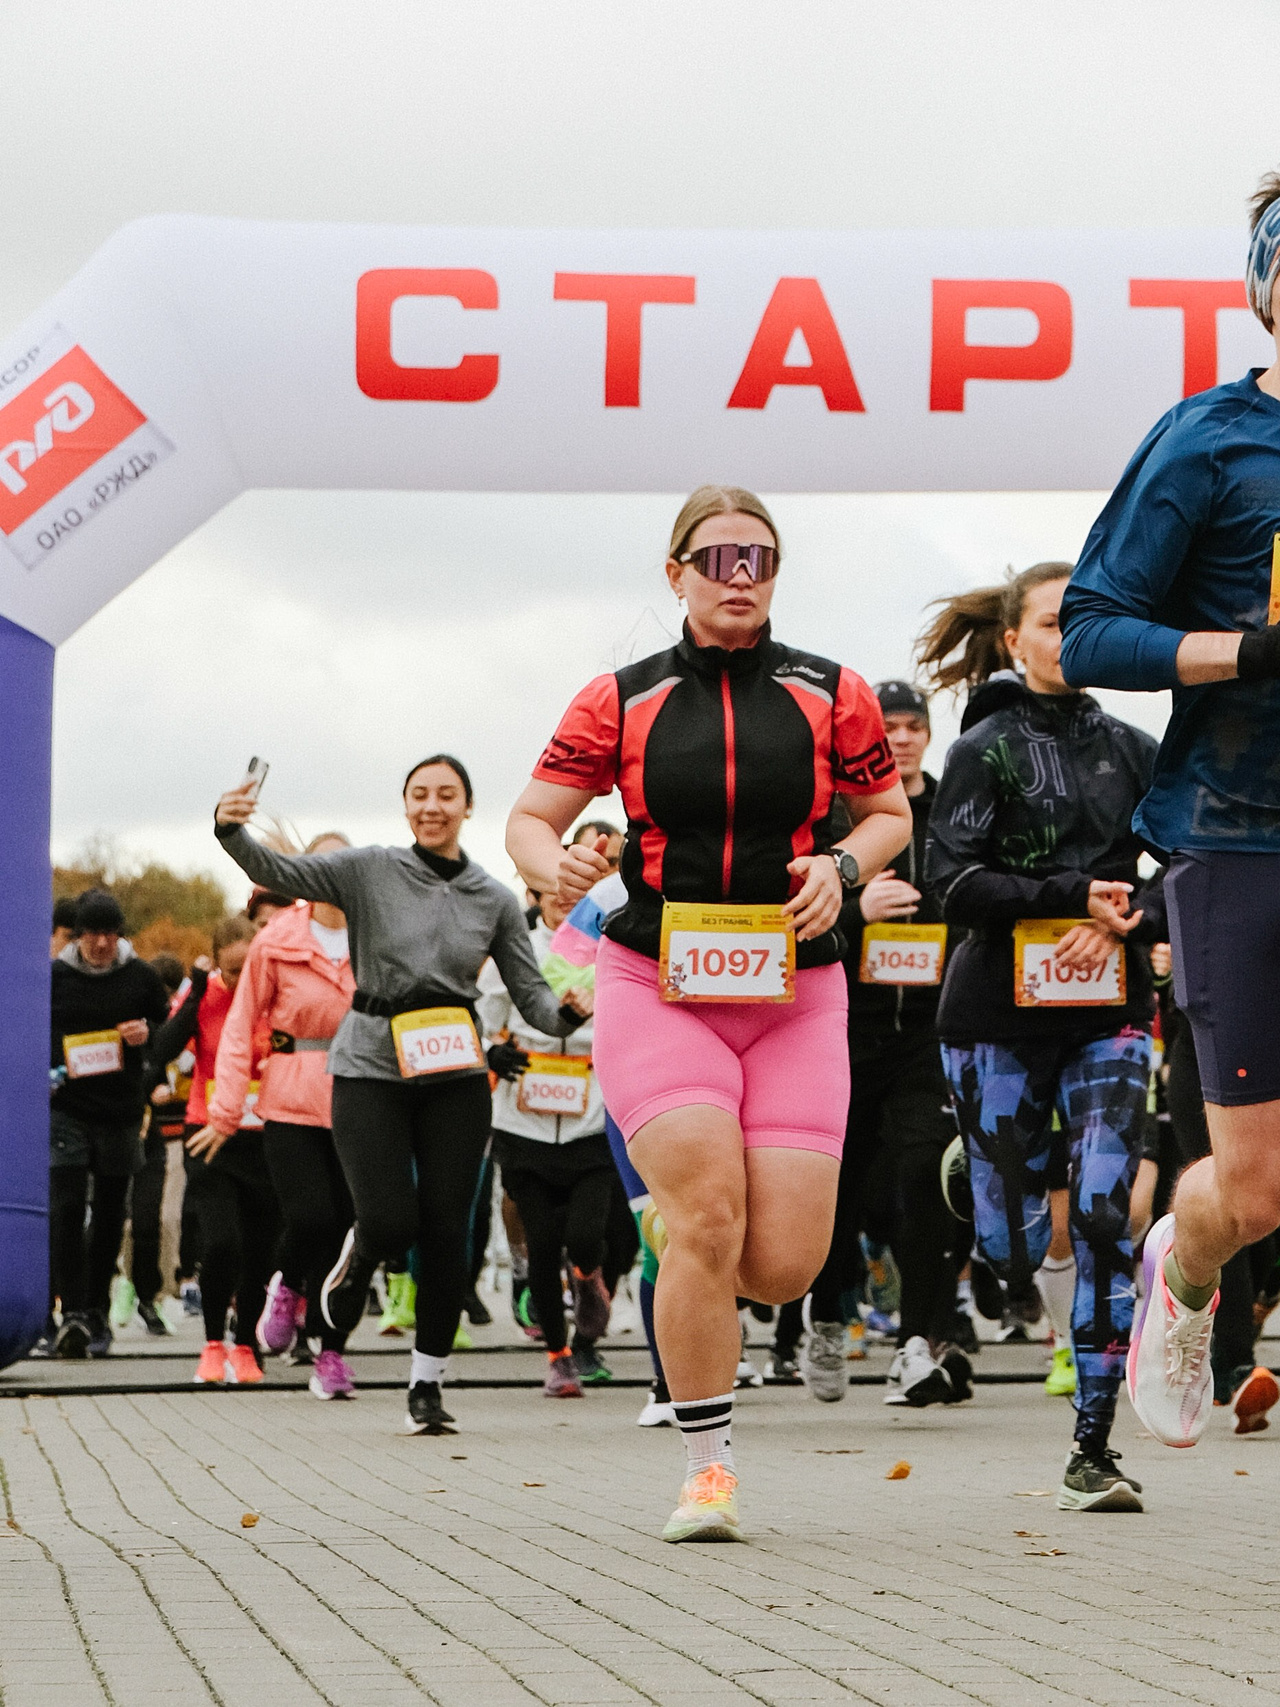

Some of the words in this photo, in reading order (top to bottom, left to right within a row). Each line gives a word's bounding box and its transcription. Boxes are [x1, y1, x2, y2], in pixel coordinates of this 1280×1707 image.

[356, 267, 1246, 413] СТАРТ
[36, 508, 83, 551] ОАО
[686, 948, 770, 977] 1097
[878, 951, 929, 970] 1043
[416, 1035, 465, 1057] 1074
[531, 1083, 577, 1101] 1060
